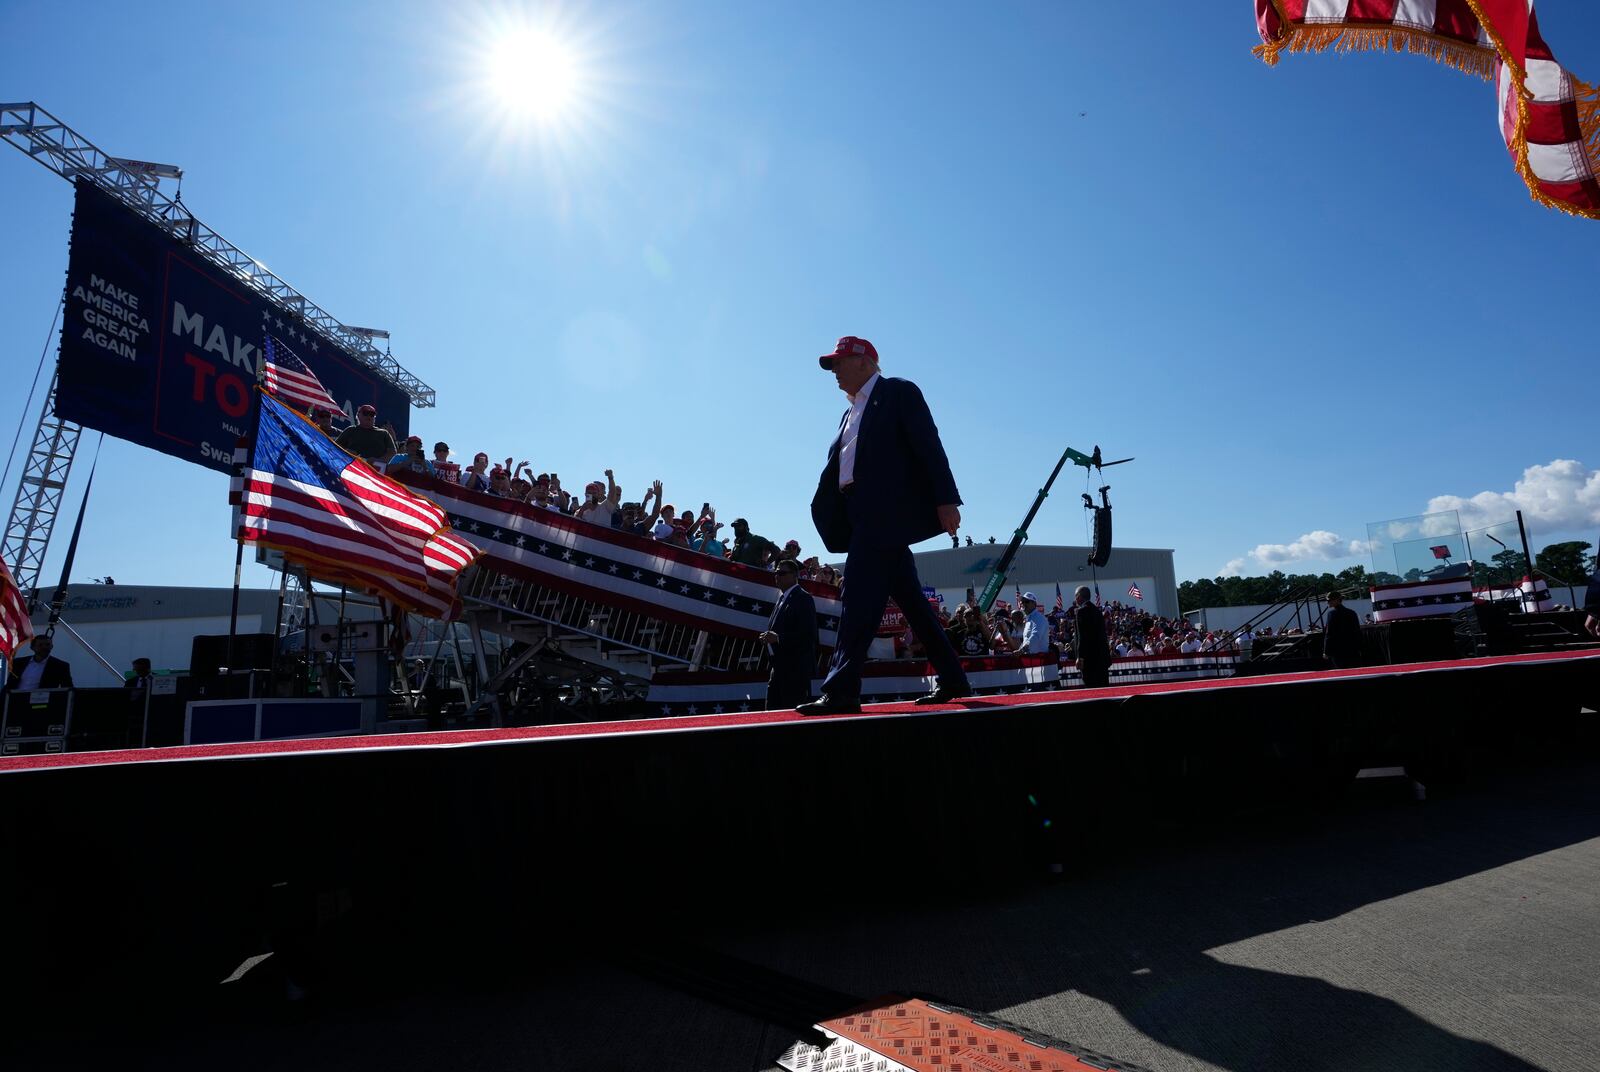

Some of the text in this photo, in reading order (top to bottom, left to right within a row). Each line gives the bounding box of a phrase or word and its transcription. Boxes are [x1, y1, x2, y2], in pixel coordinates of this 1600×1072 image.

[72, 285, 150, 333] AMERICA
[90, 273, 139, 310] MAKE
[81, 327, 137, 361] AGAIN
[82, 308, 139, 344] GREAT
[184, 351, 250, 417] TO
[222, 421, 241, 437] MAIL
[200, 441, 234, 466] Swa
